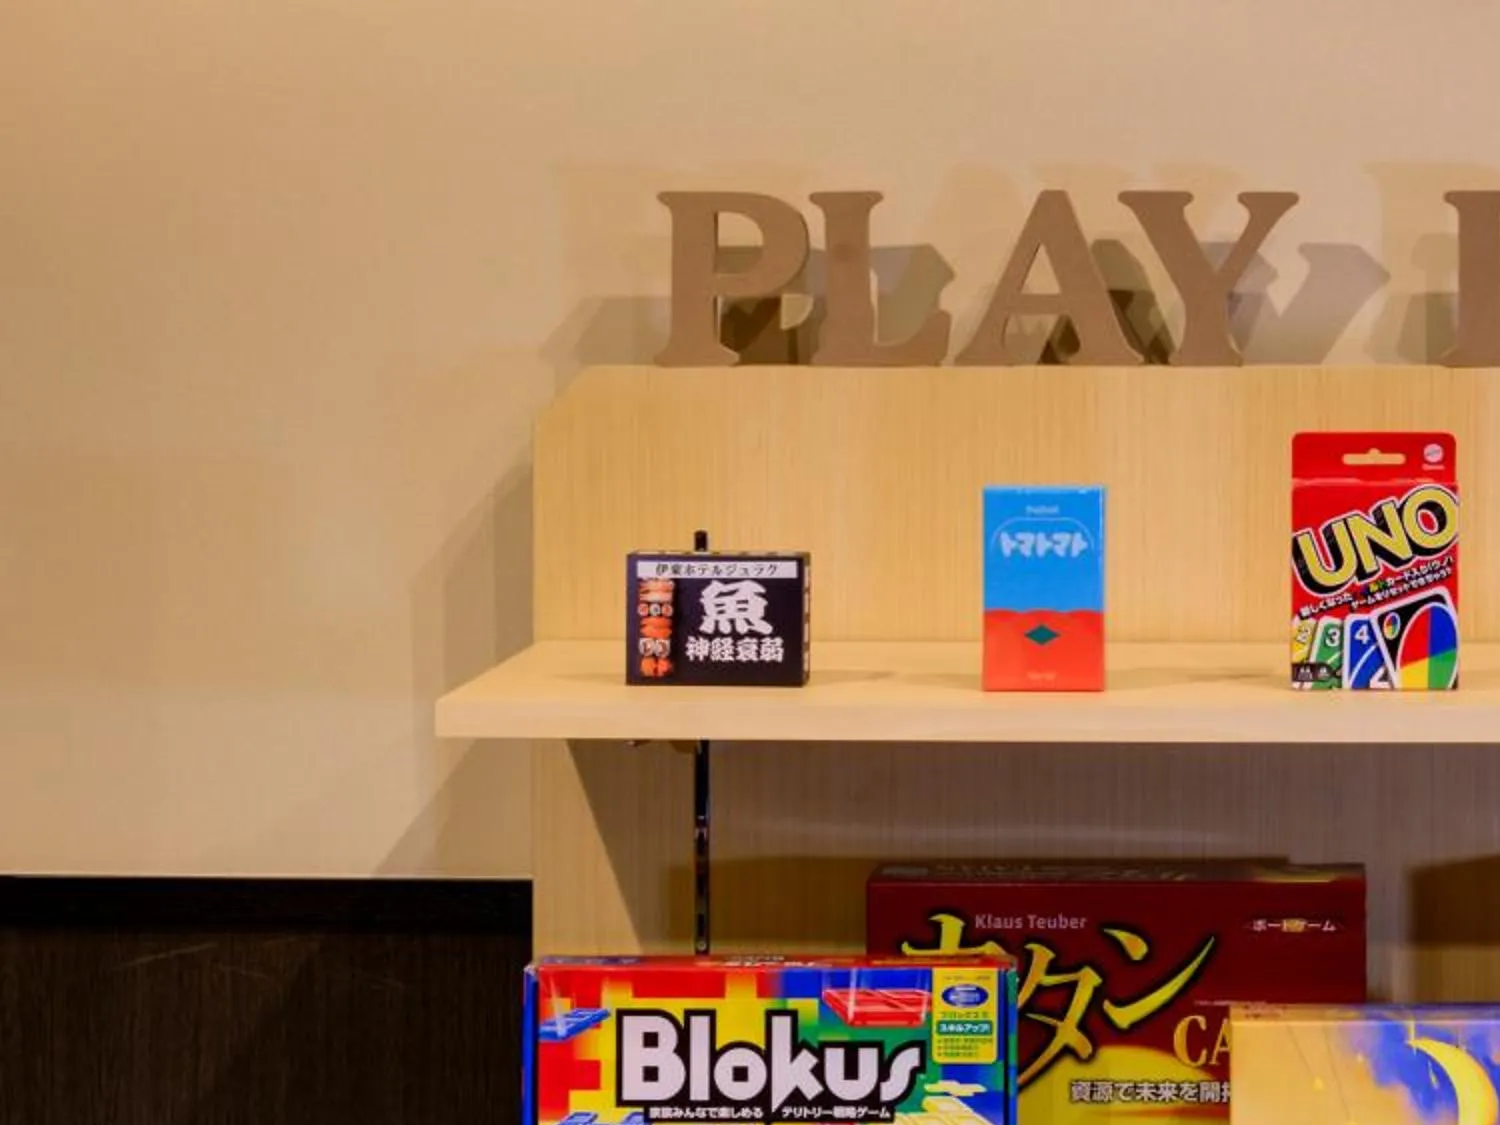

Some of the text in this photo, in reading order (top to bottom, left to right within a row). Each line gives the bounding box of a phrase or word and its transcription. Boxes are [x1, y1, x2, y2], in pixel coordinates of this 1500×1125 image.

[655, 189, 1300, 367] PLAY
[1001, 531, 1089, 558] トマトマト
[1293, 485, 1459, 595] UNO
[655, 563, 779, 577] 伊東ホテルジュラク
[699, 579, 773, 635] 魚
[1325, 627, 1341, 648] 3
[1354, 624, 1371, 644] 4
[685, 635, 785, 663] 神経衰弱
[975, 913, 1088, 931] Klaus Teuber
[1252, 918, 1338, 933] ボードゲーム
[901, 913, 1215, 1084] タン
[1173, 1015, 1229, 1068] CA
[619, 1012, 923, 1112] Blokus
